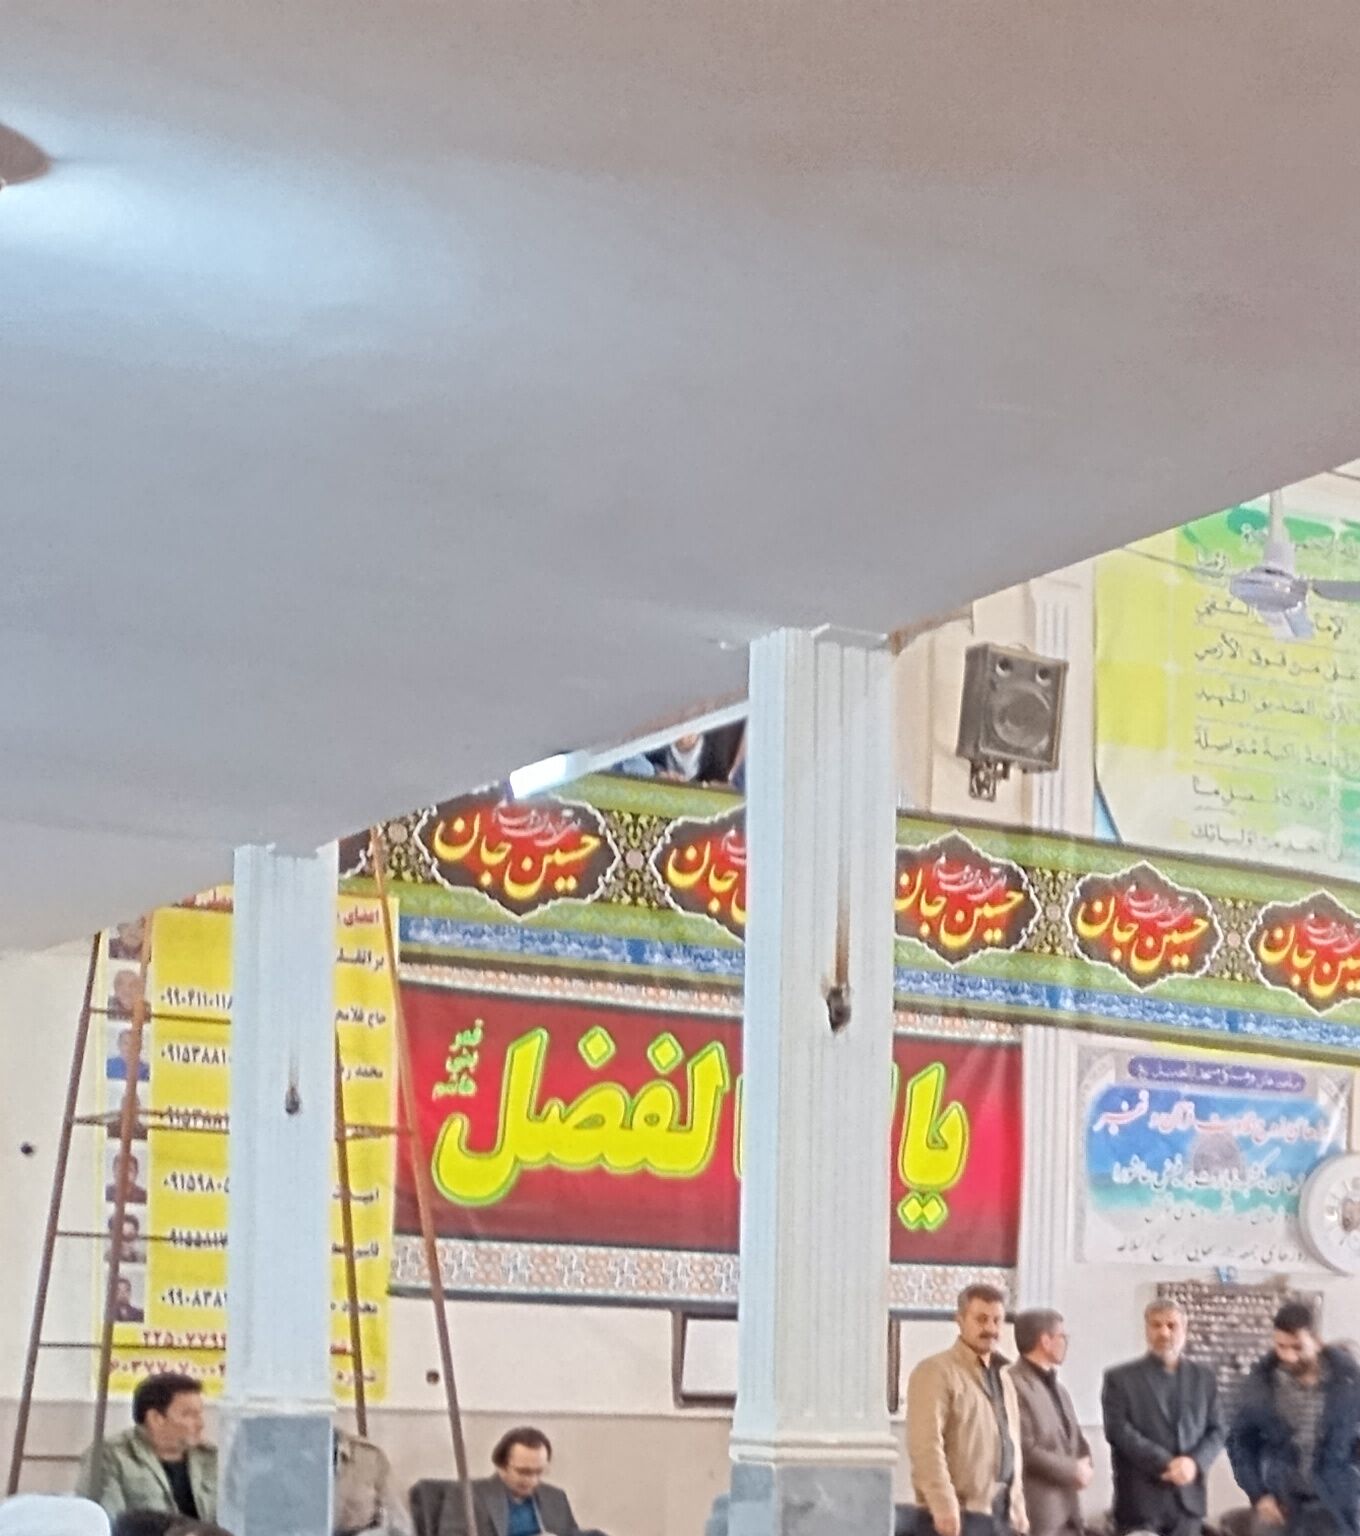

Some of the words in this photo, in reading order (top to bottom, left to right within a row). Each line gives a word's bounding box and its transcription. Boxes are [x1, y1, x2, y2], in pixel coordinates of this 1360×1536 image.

[433, 812, 513, 886] جان
[504, 833, 601, 899] حسین
[666, 840, 739, 913] جان
[940, 890, 1024, 948] حسین
[1076, 895, 1139, 963] جان
[1130, 917, 1209, 974] حسین
[1258, 924, 1316, 988] جان
[898, 1062, 970, 1232] یا
